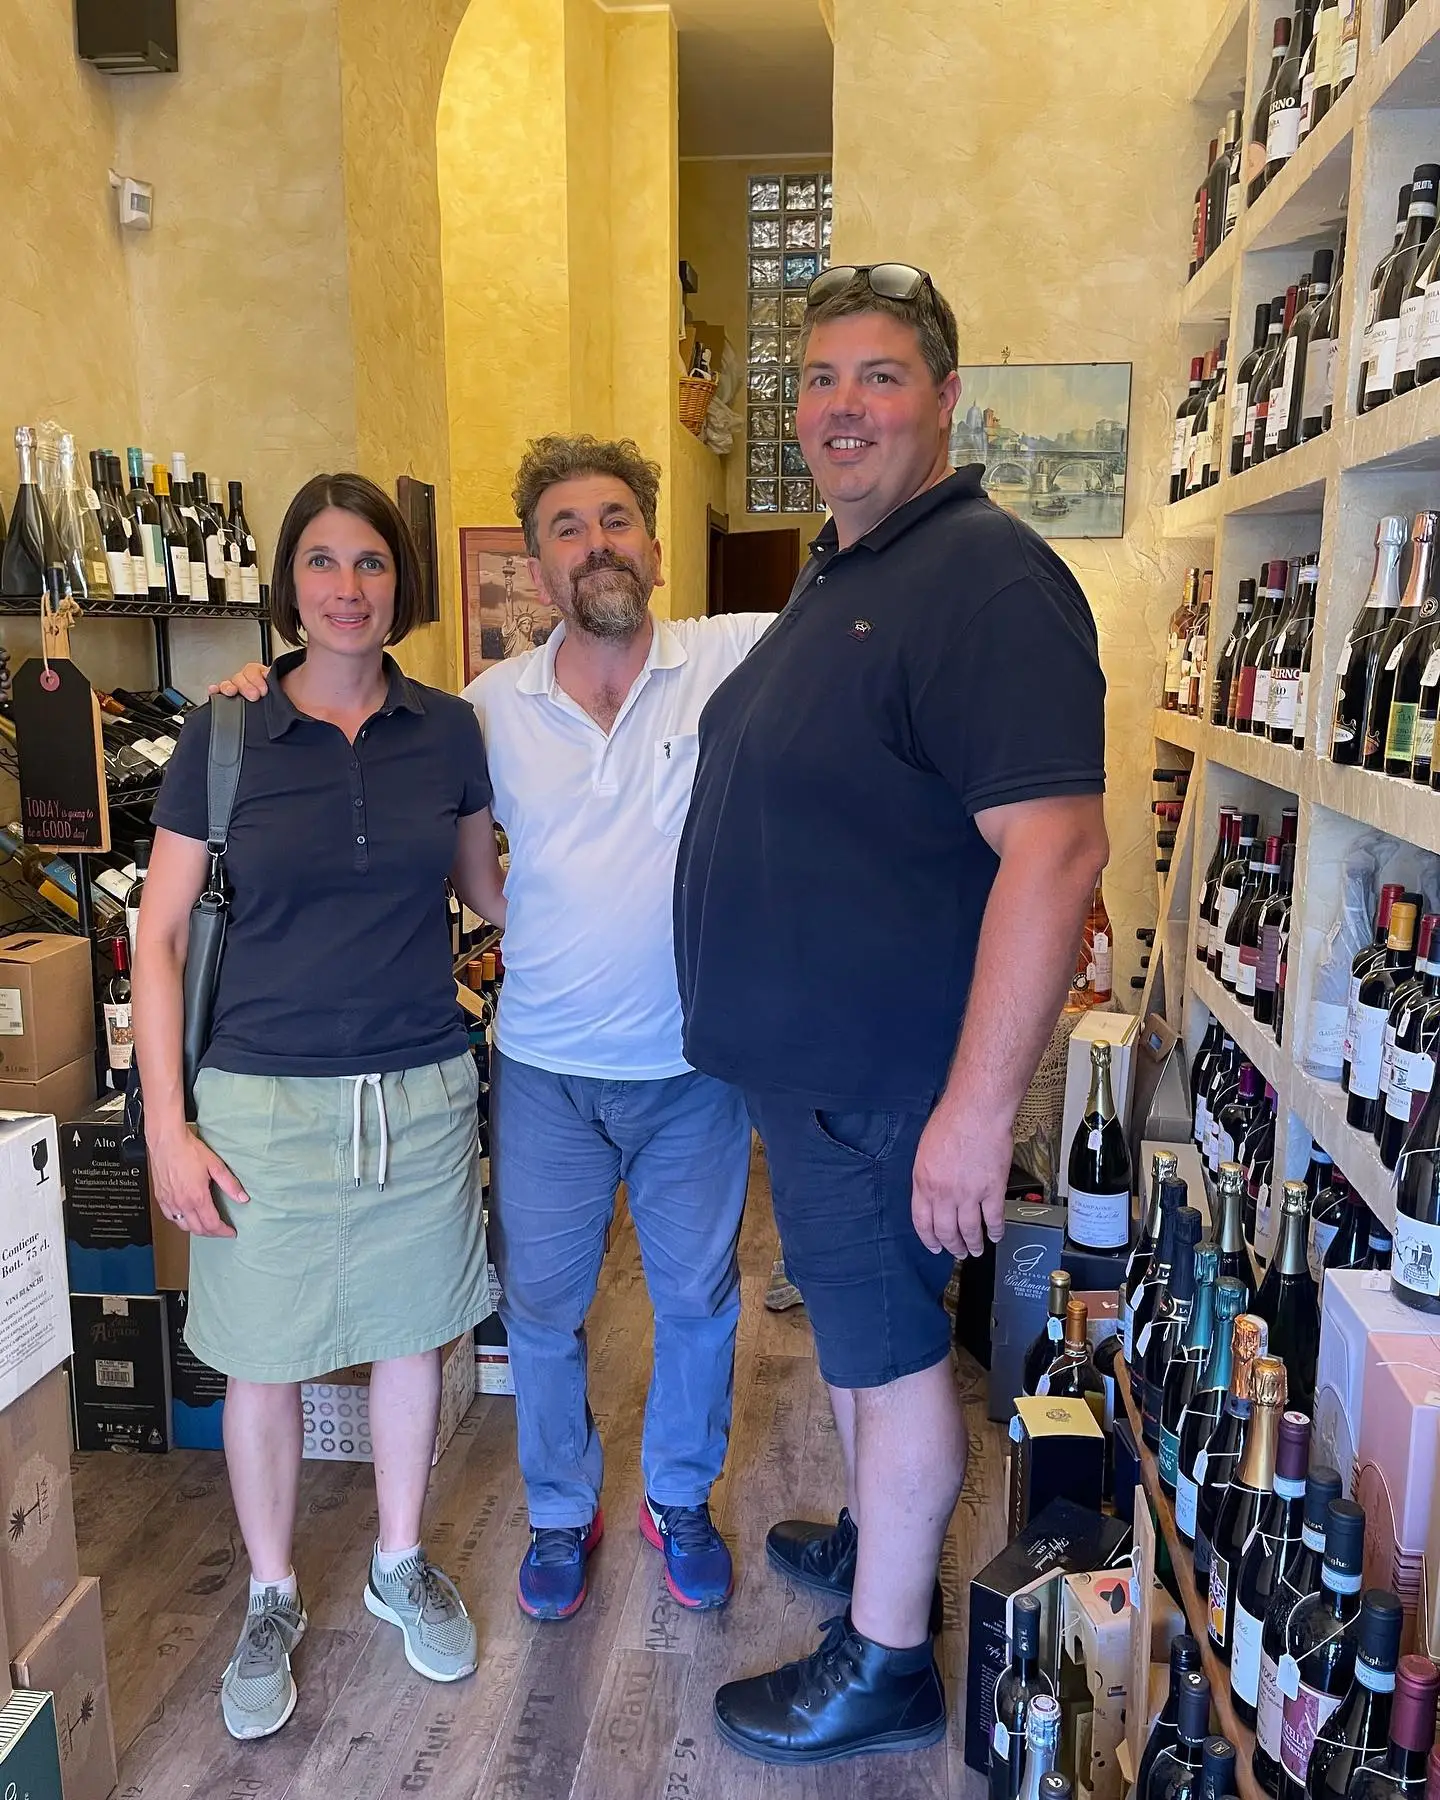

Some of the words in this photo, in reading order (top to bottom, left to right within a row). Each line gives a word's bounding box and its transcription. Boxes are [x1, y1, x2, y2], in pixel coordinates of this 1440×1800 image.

[25, 797, 59, 817] TODAY
[42, 821, 71, 838] GOOD
[93, 1137, 116, 1148] Alto
[2, 1232, 40, 1261] Contiene
[2, 1259, 24, 1279] Bott.
